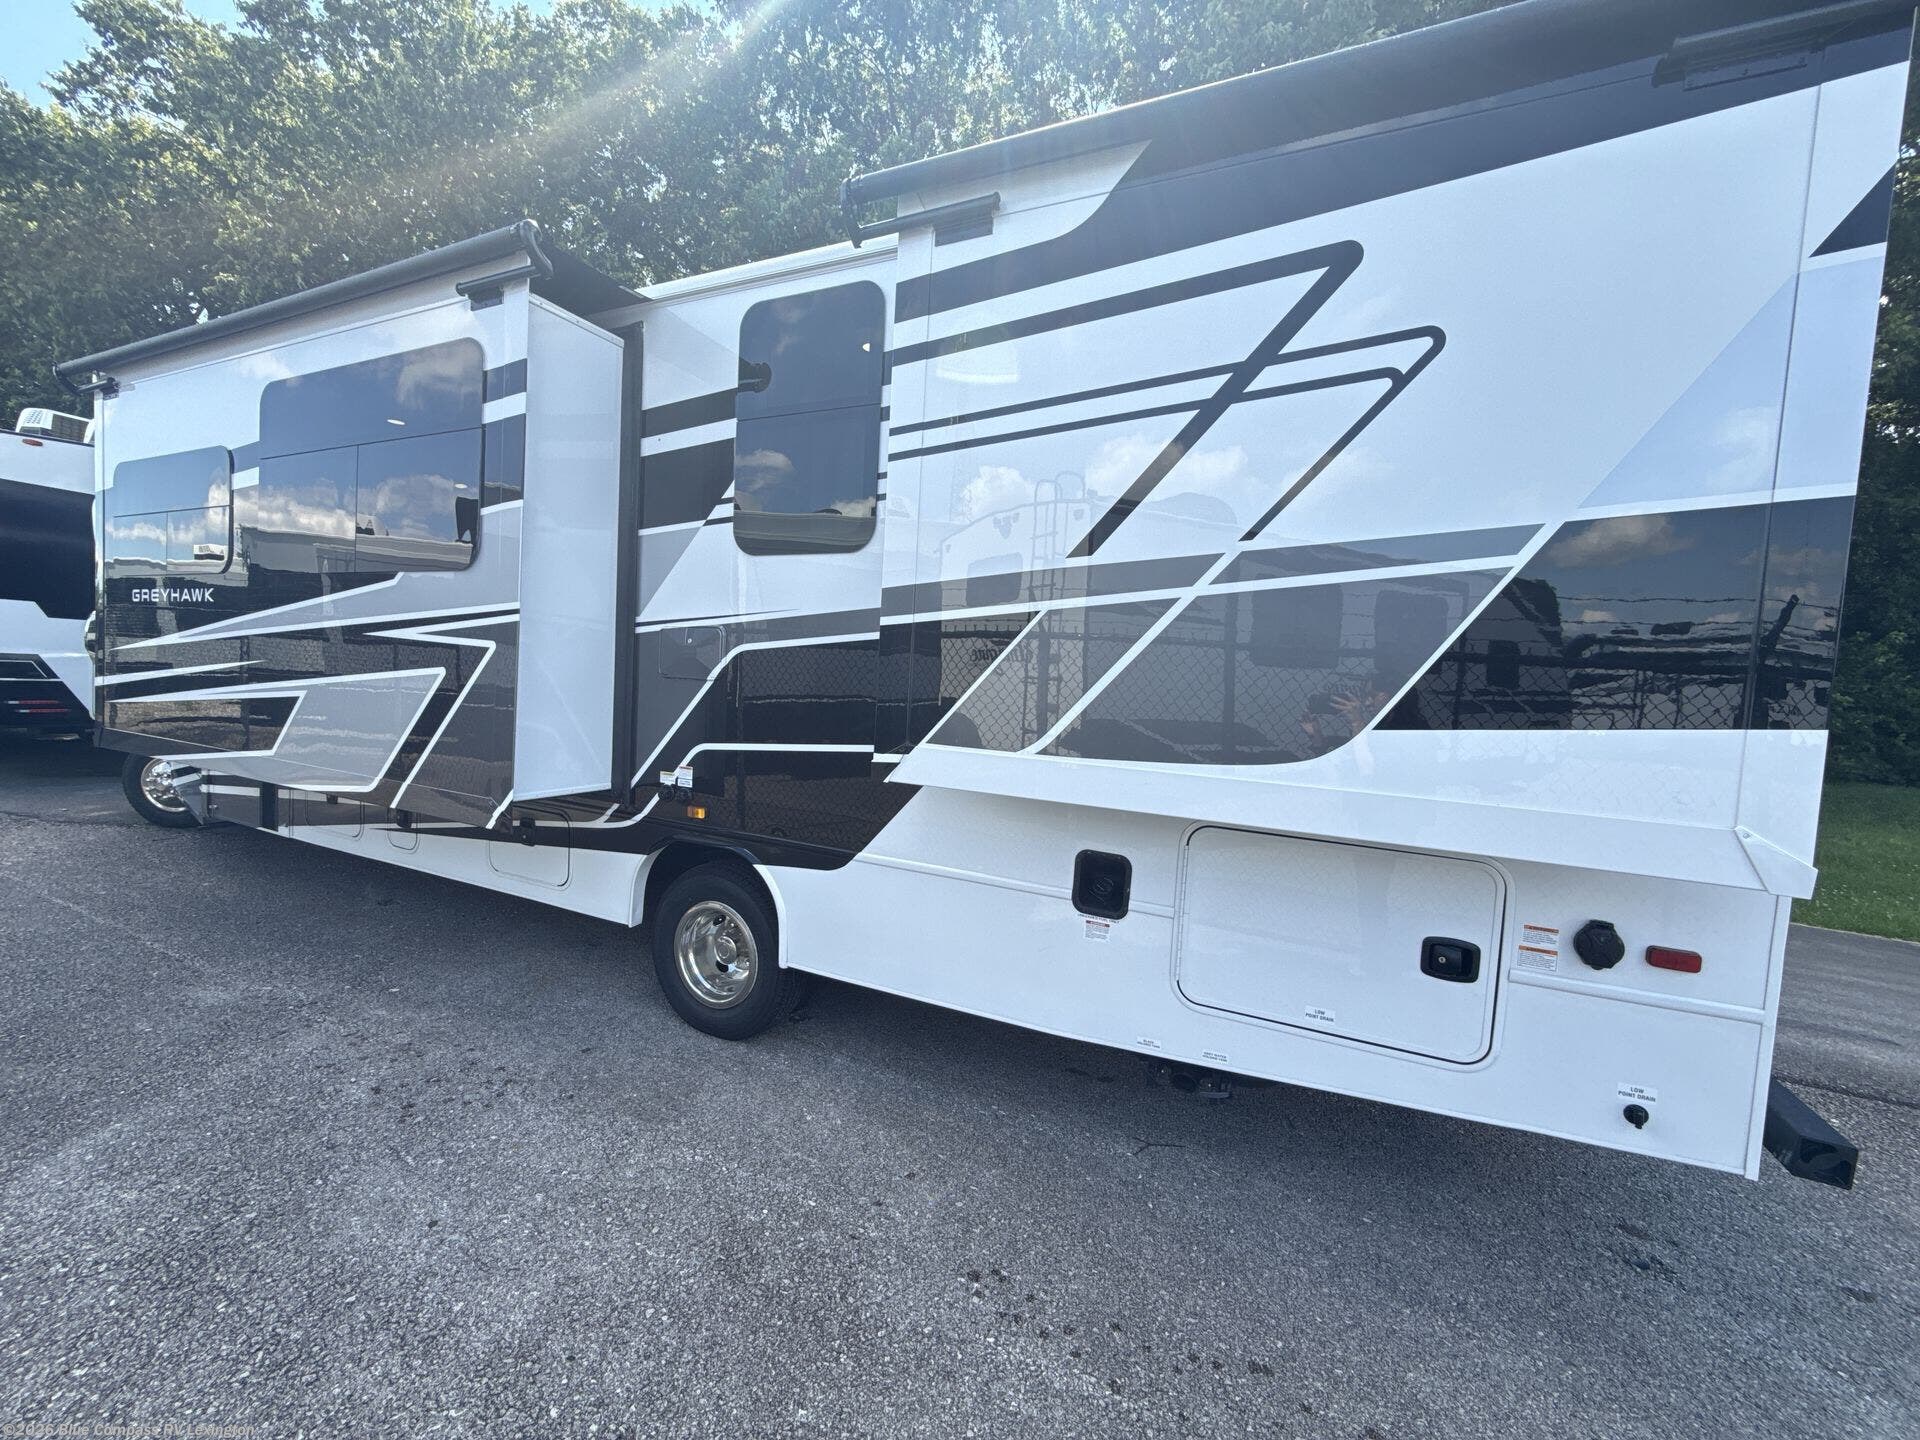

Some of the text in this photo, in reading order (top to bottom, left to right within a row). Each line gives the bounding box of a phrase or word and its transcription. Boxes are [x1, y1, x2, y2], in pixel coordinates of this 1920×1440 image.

[131, 588, 215, 602] GREYHAWK
[1618, 1090, 1656, 1102] POINT DRAIN
